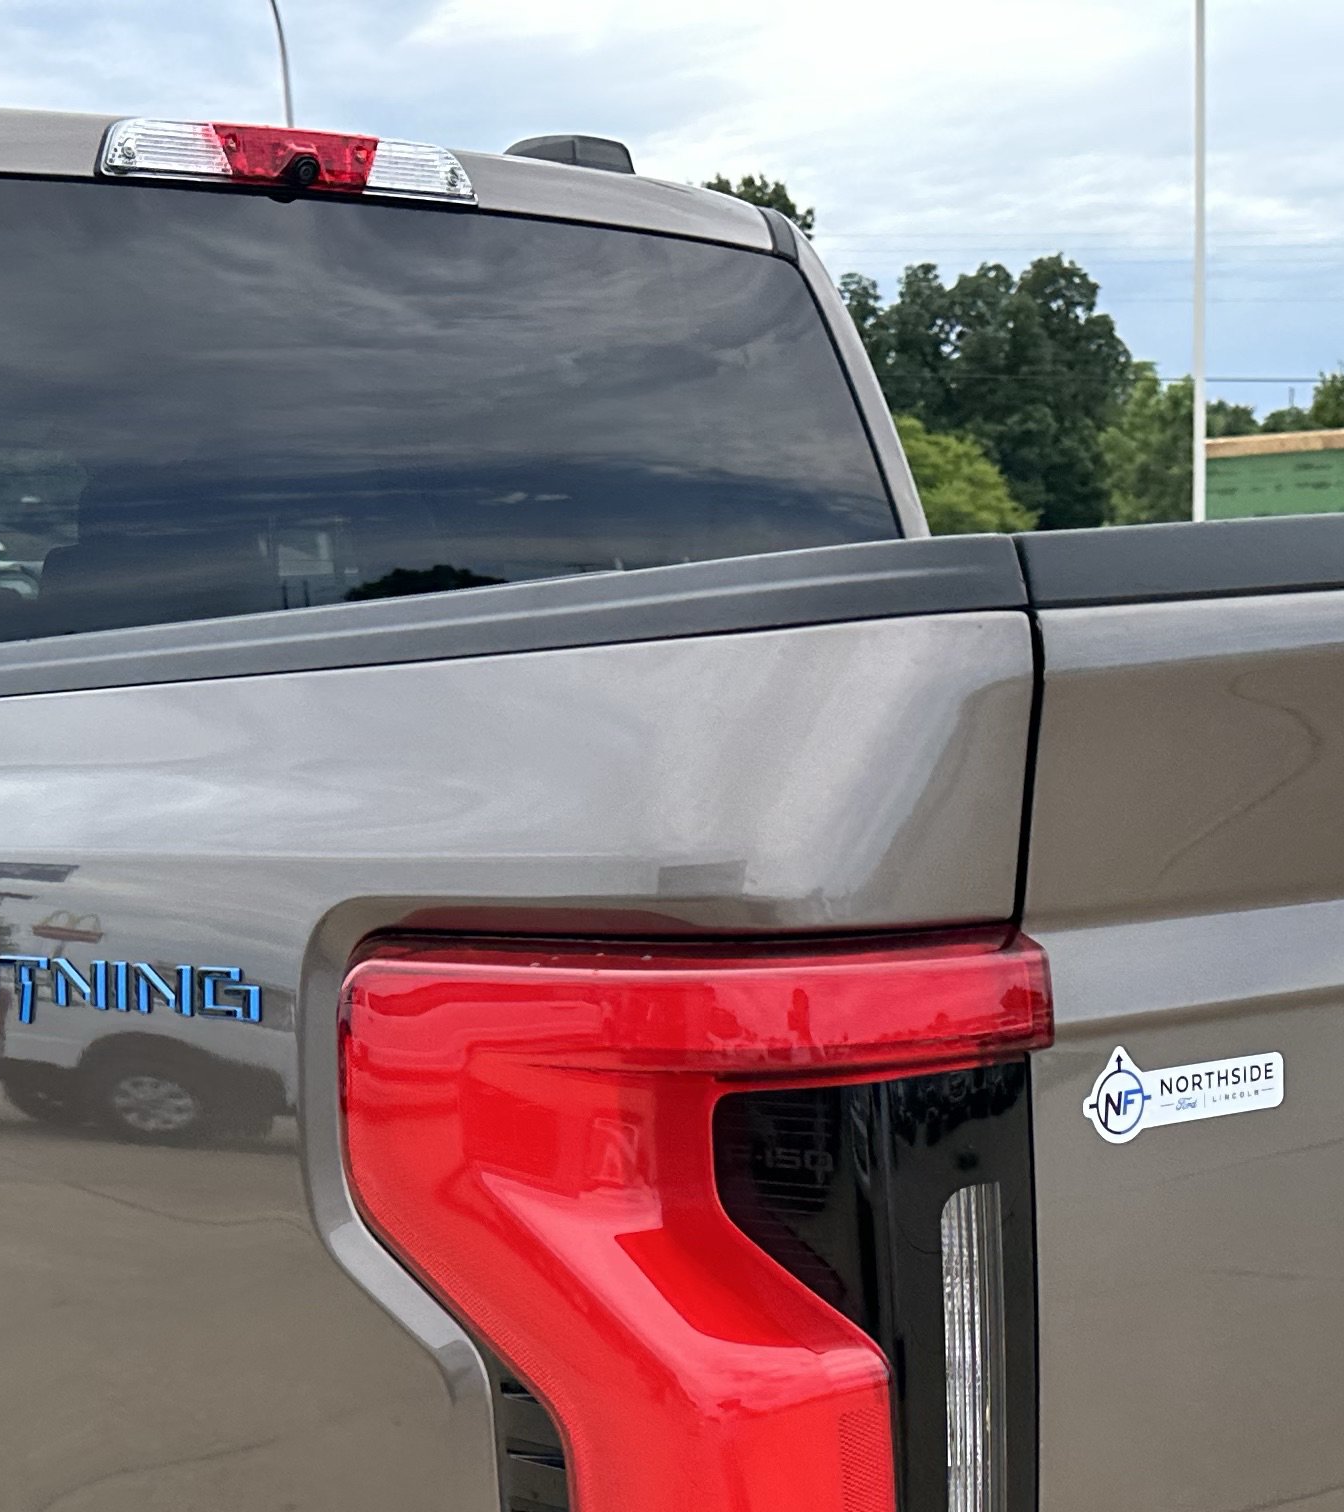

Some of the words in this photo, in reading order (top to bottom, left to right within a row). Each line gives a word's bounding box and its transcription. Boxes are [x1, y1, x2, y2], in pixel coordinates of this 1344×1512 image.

[1159, 1061, 1275, 1097] NORTHSIDE
[1103, 1087, 1144, 1128] NF
[1174, 1096, 1198, 1112] Ford
